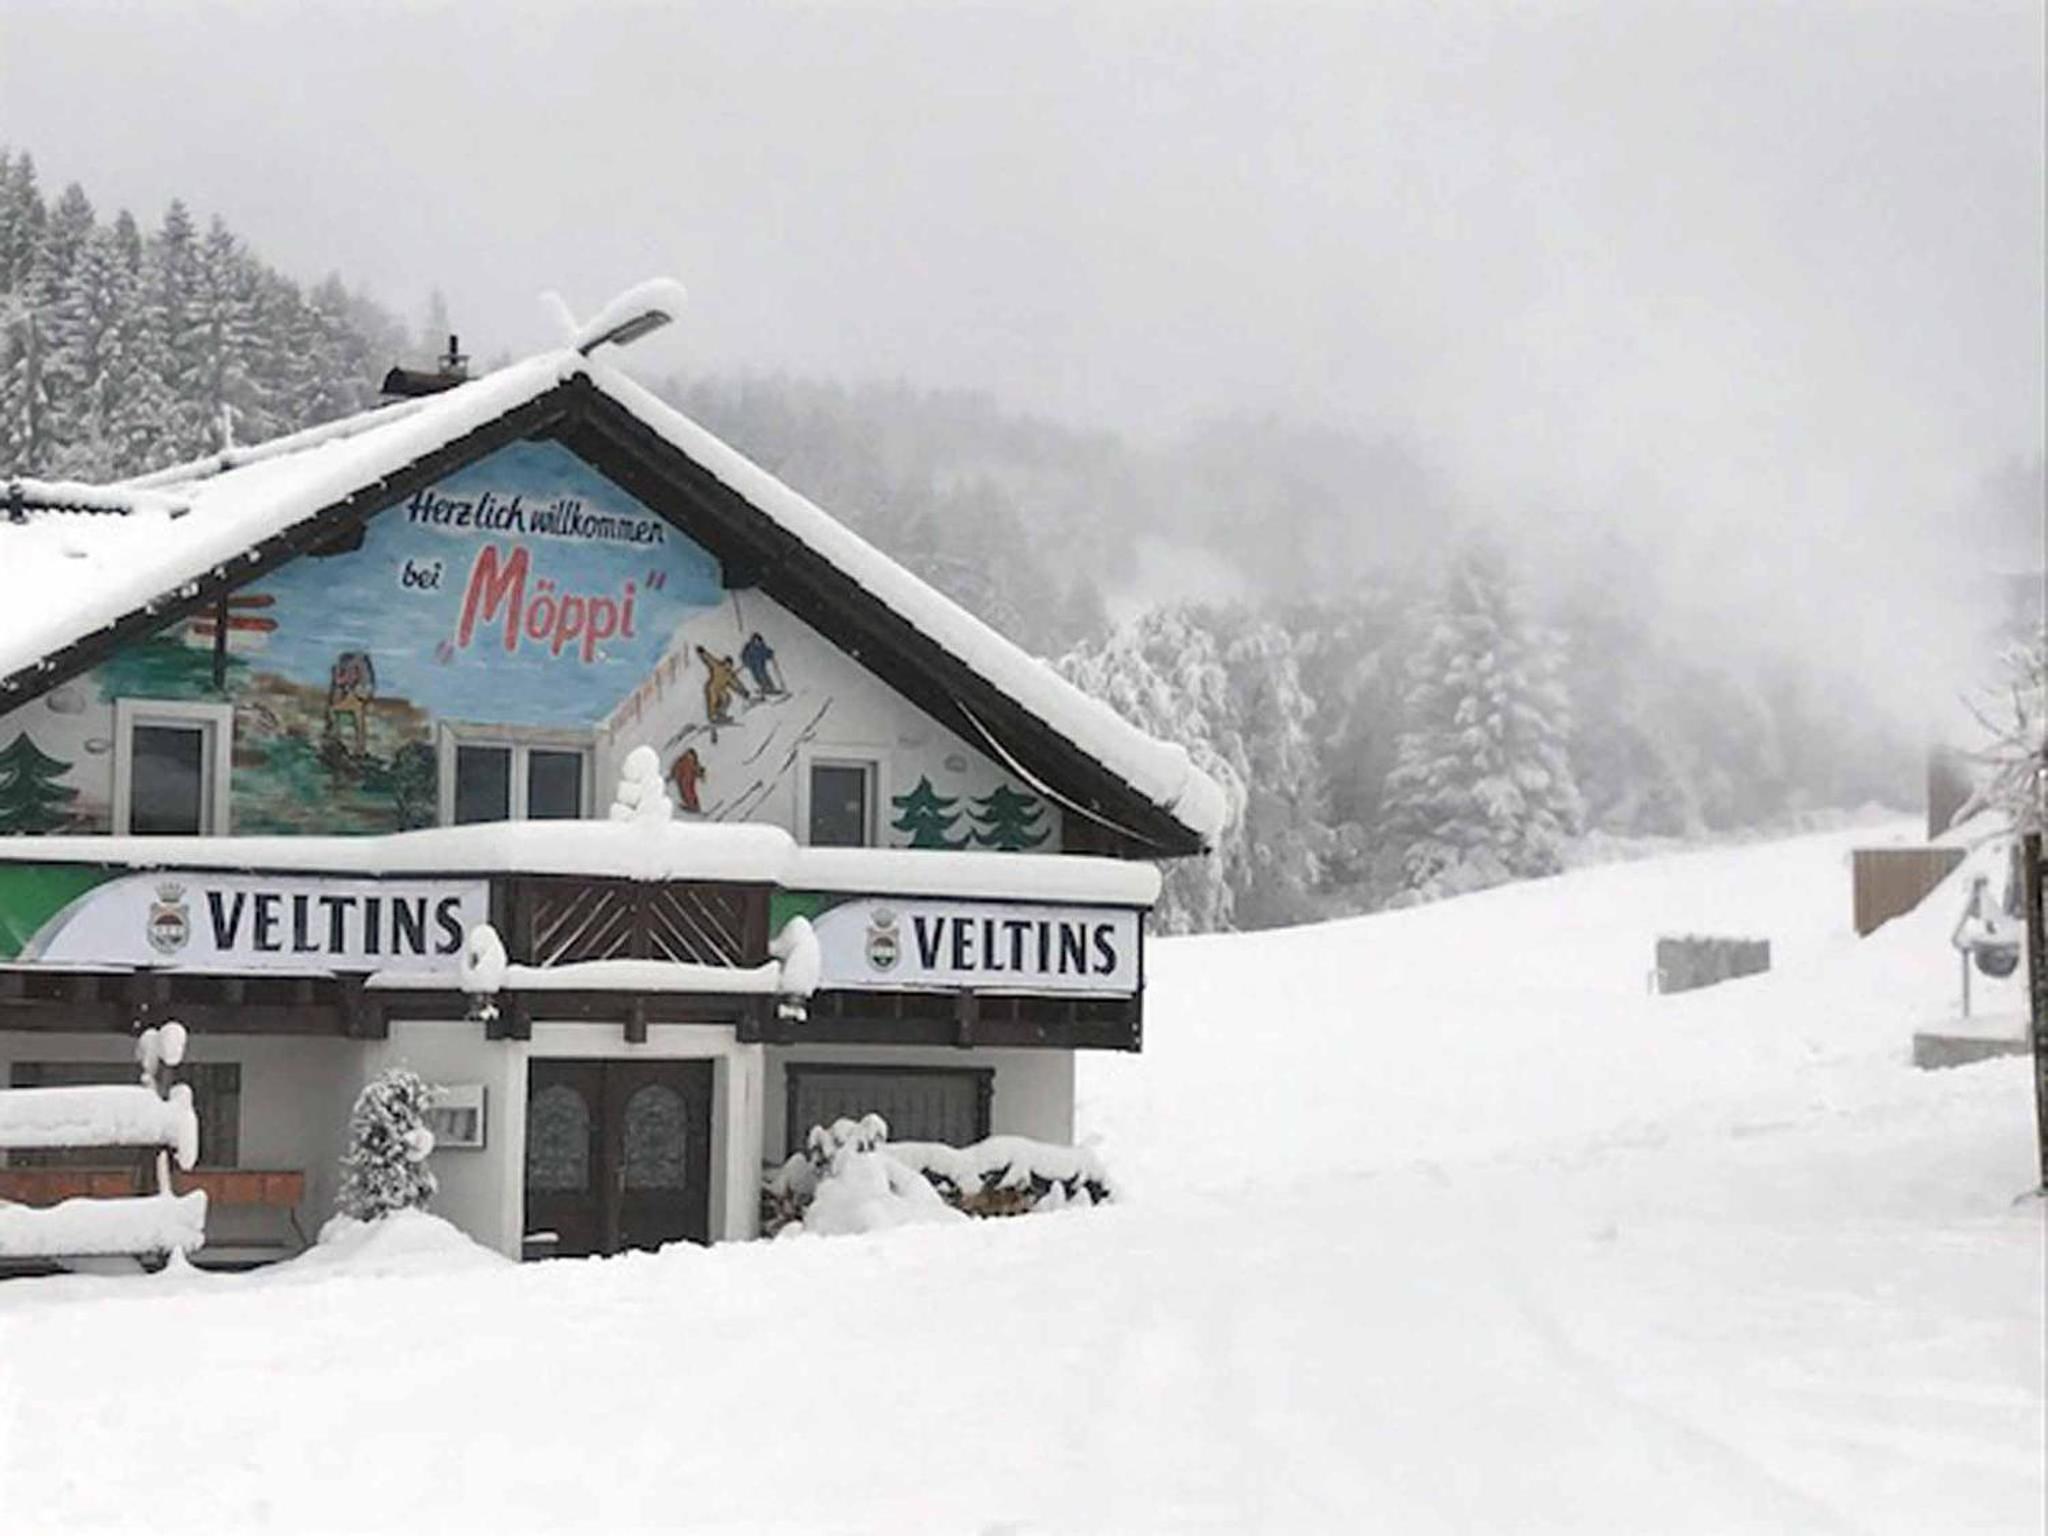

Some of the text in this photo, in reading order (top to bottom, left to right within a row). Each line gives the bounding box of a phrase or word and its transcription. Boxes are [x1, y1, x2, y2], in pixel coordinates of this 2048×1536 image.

[407, 491, 665, 544] Herzlich willkommen
[402, 561, 443, 590] bei
[206, 890, 464, 956] VELTINS
[912, 915, 1117, 977] VELTINS
